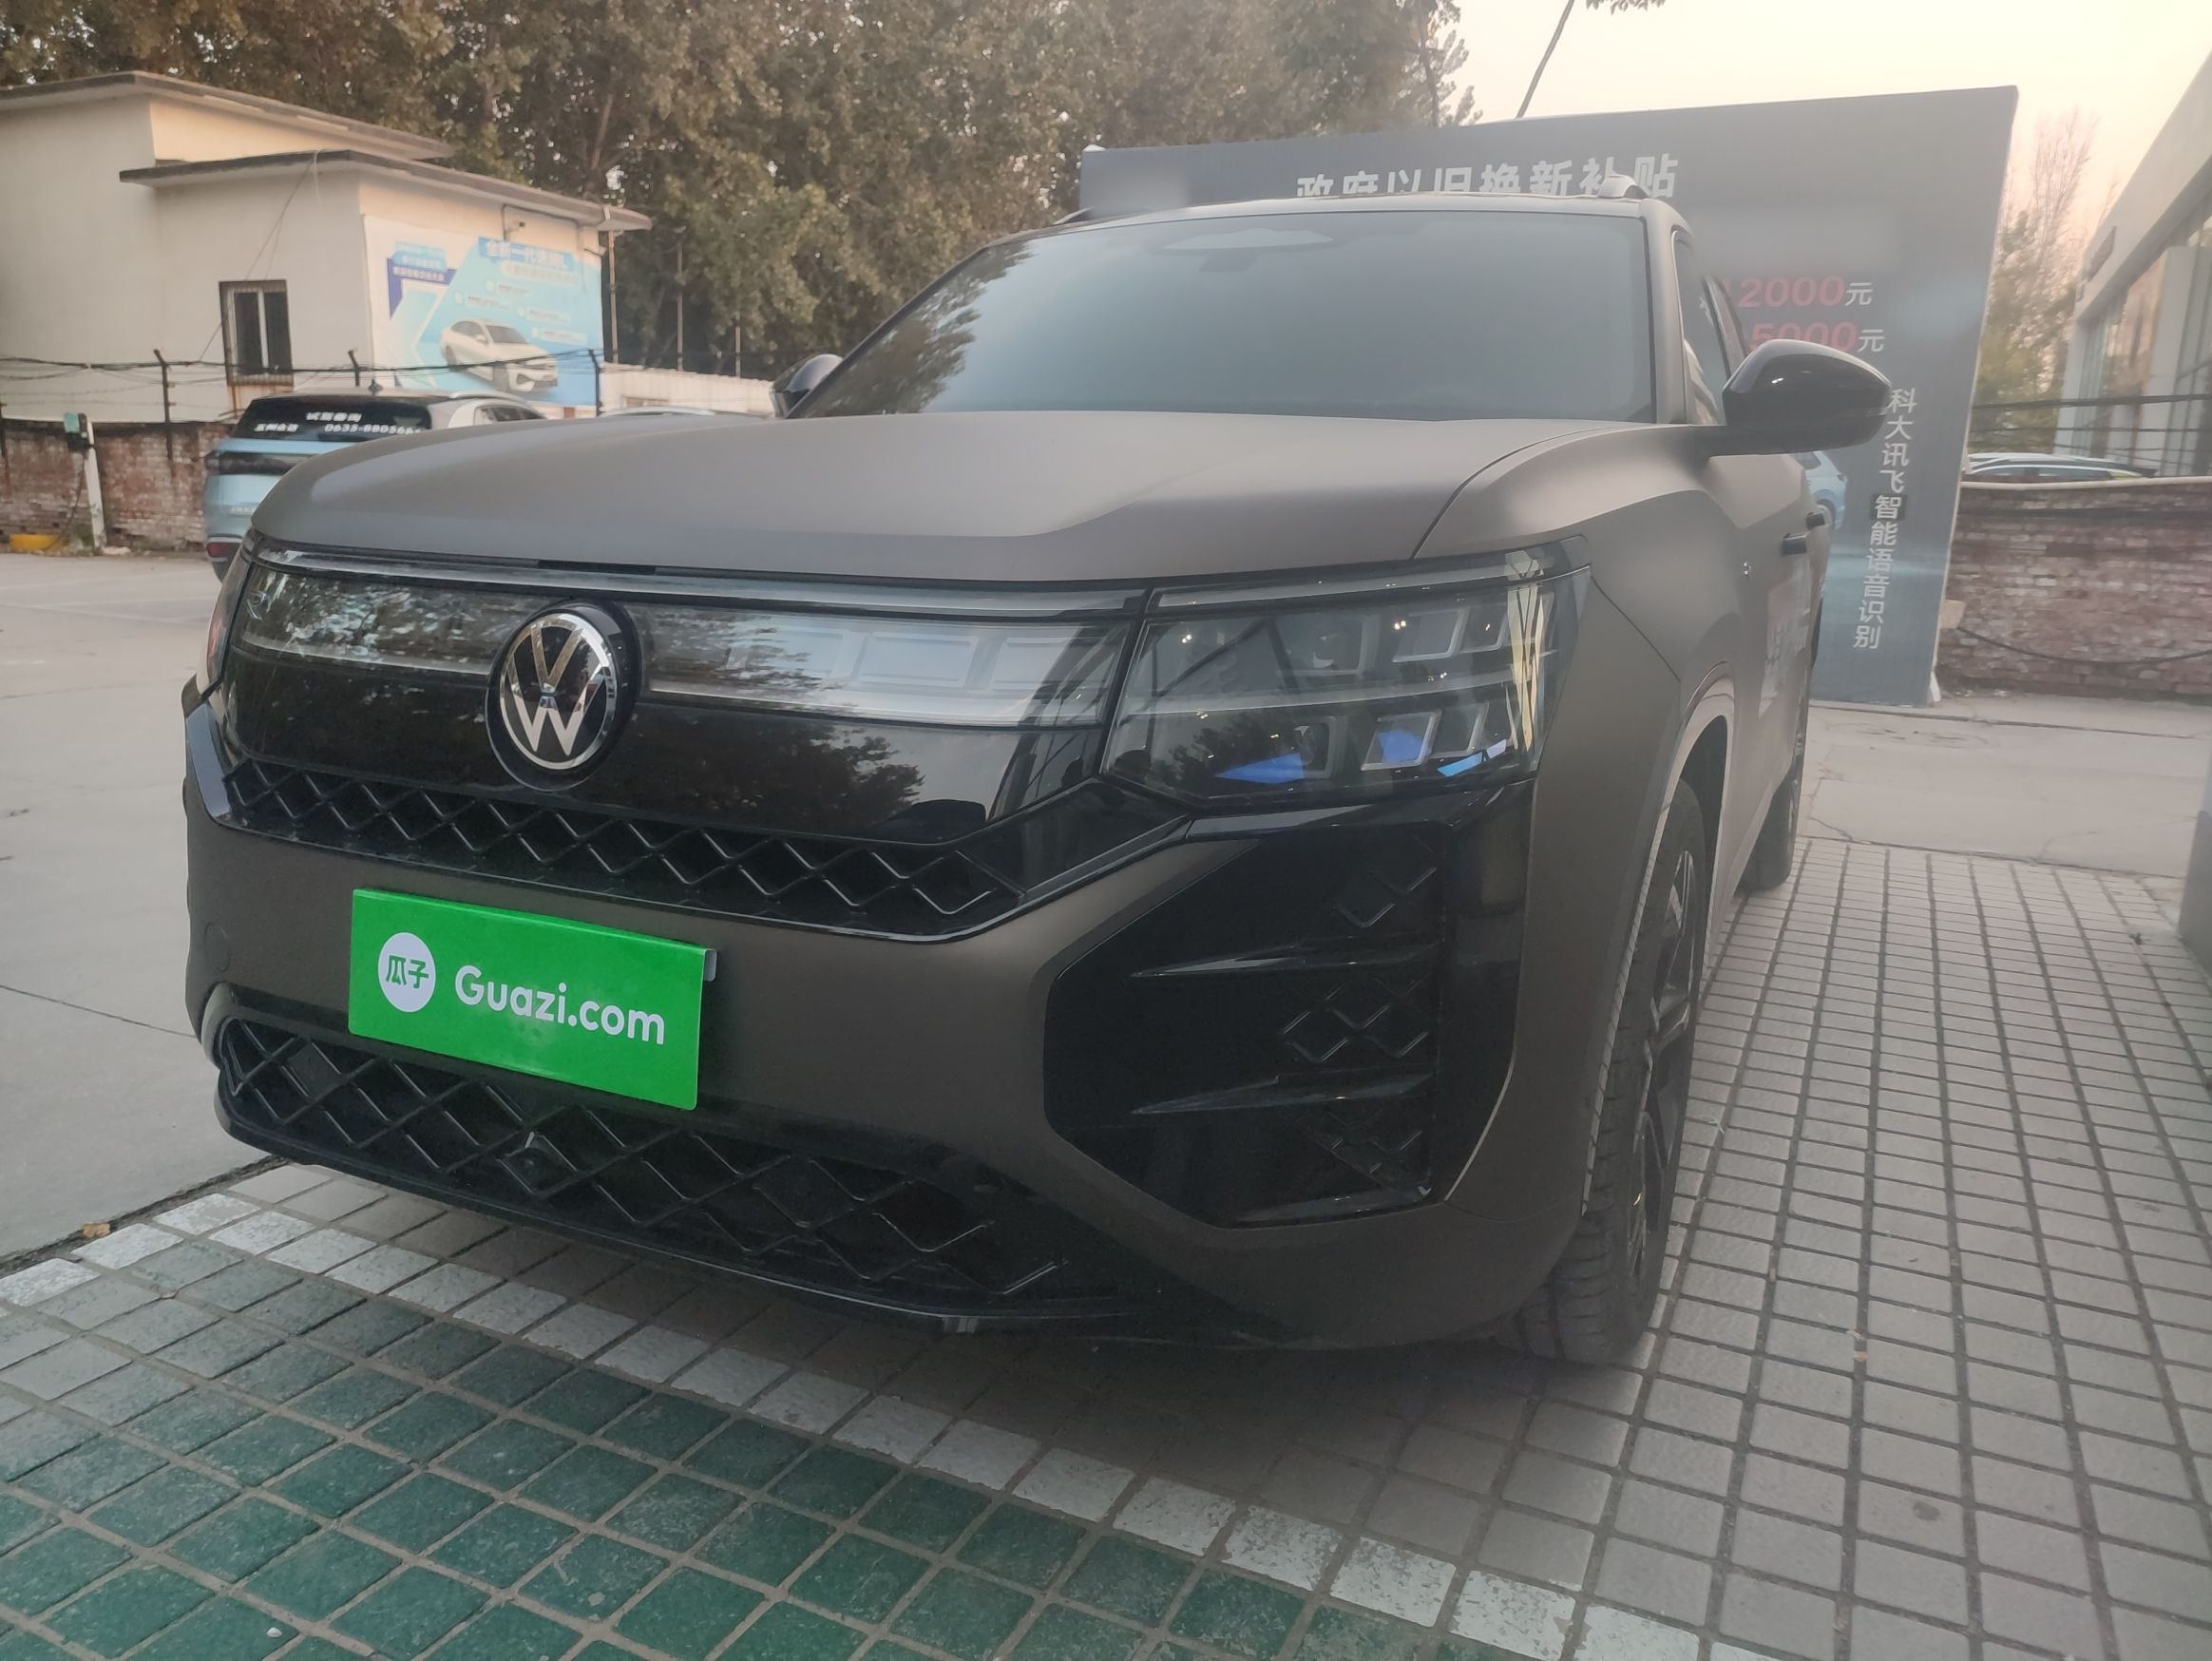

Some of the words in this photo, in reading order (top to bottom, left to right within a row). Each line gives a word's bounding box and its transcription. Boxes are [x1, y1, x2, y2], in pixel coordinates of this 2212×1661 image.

[1721, 276, 1873, 309] 2000元
[1852, 388, 1917, 650] 科大讯飞智能语音识别
[385, 954, 429, 989] 瓜子
[454, 964, 665, 1045] Guazi.com
